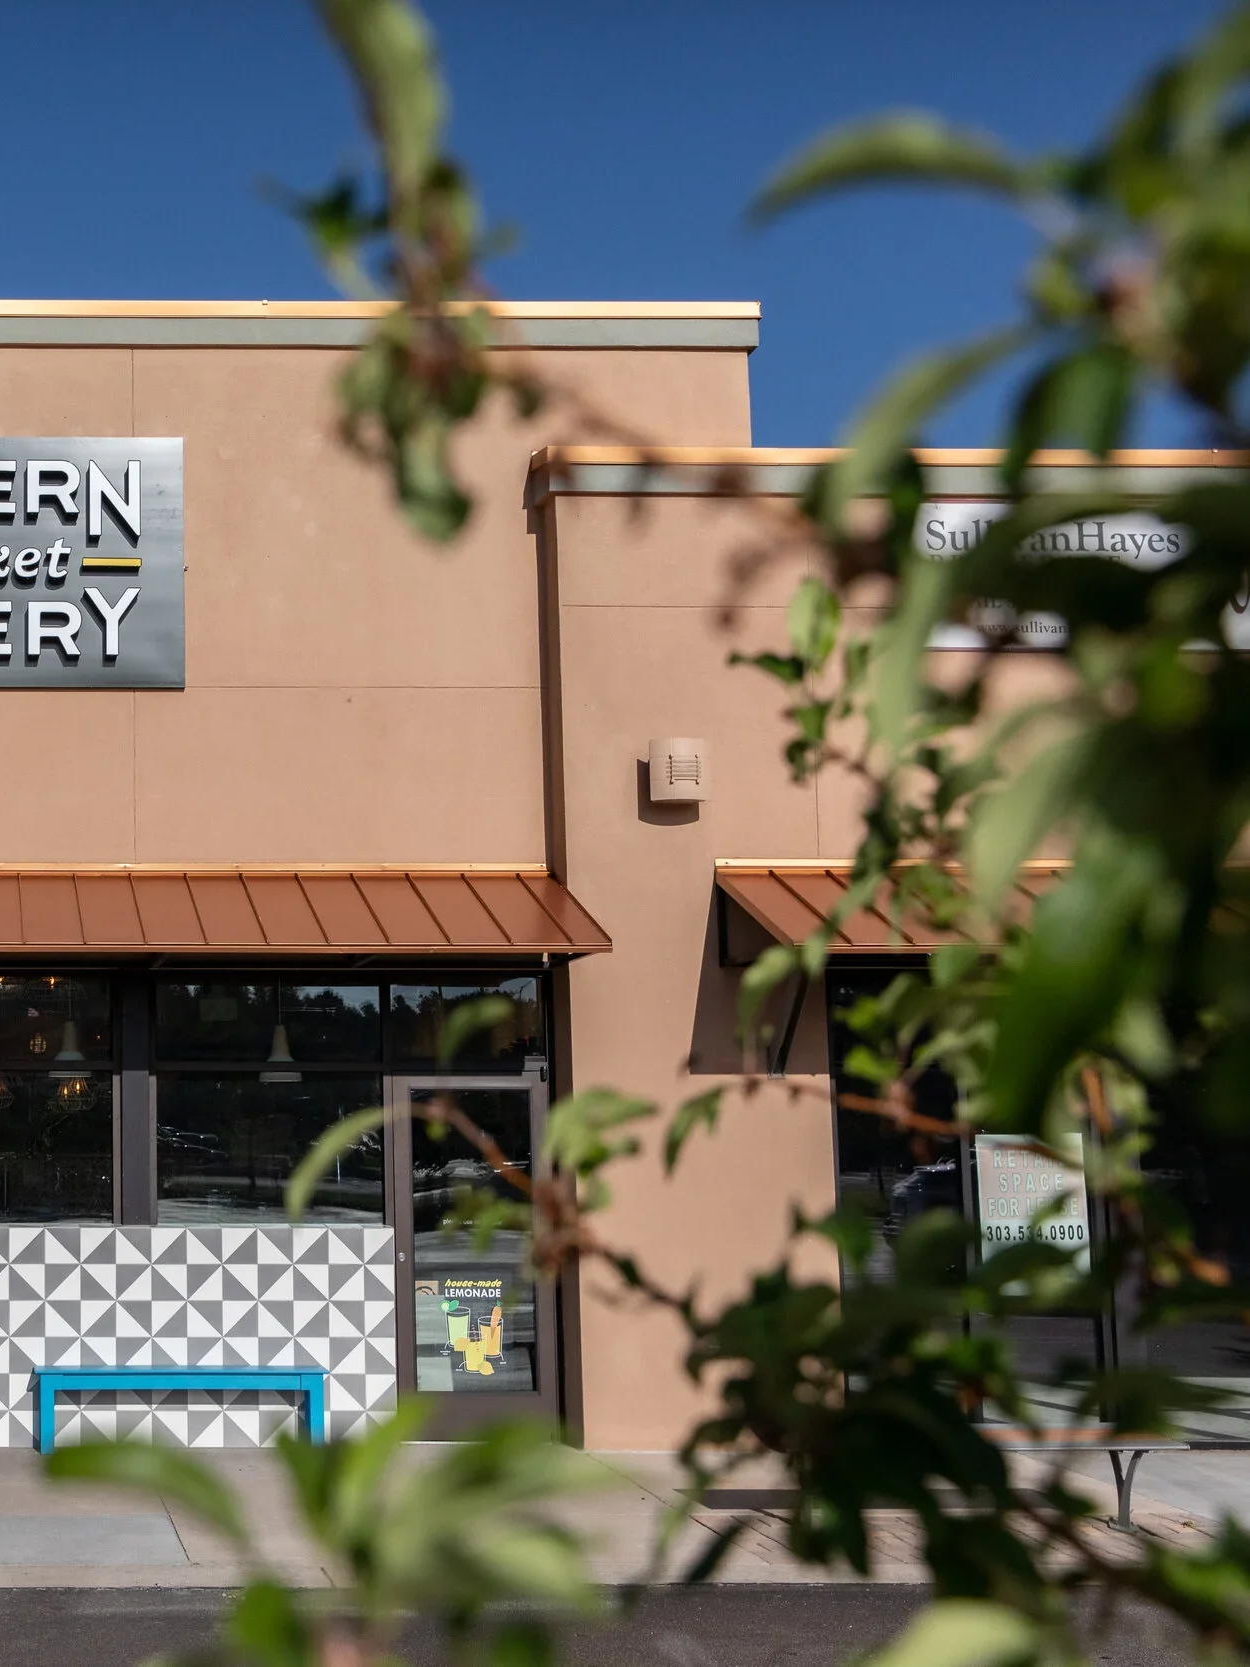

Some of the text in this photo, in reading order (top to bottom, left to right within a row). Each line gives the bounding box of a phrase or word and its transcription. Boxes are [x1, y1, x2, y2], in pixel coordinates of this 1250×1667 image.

[999, 1173, 1064, 1192] SPACE
[988, 1197, 1019, 1217] FOR
[986, 1225, 1083, 1240] 303.54.0900
[444, 1279, 502, 1287] house-made
[445, 1288, 501, 1297] LEMONADE
